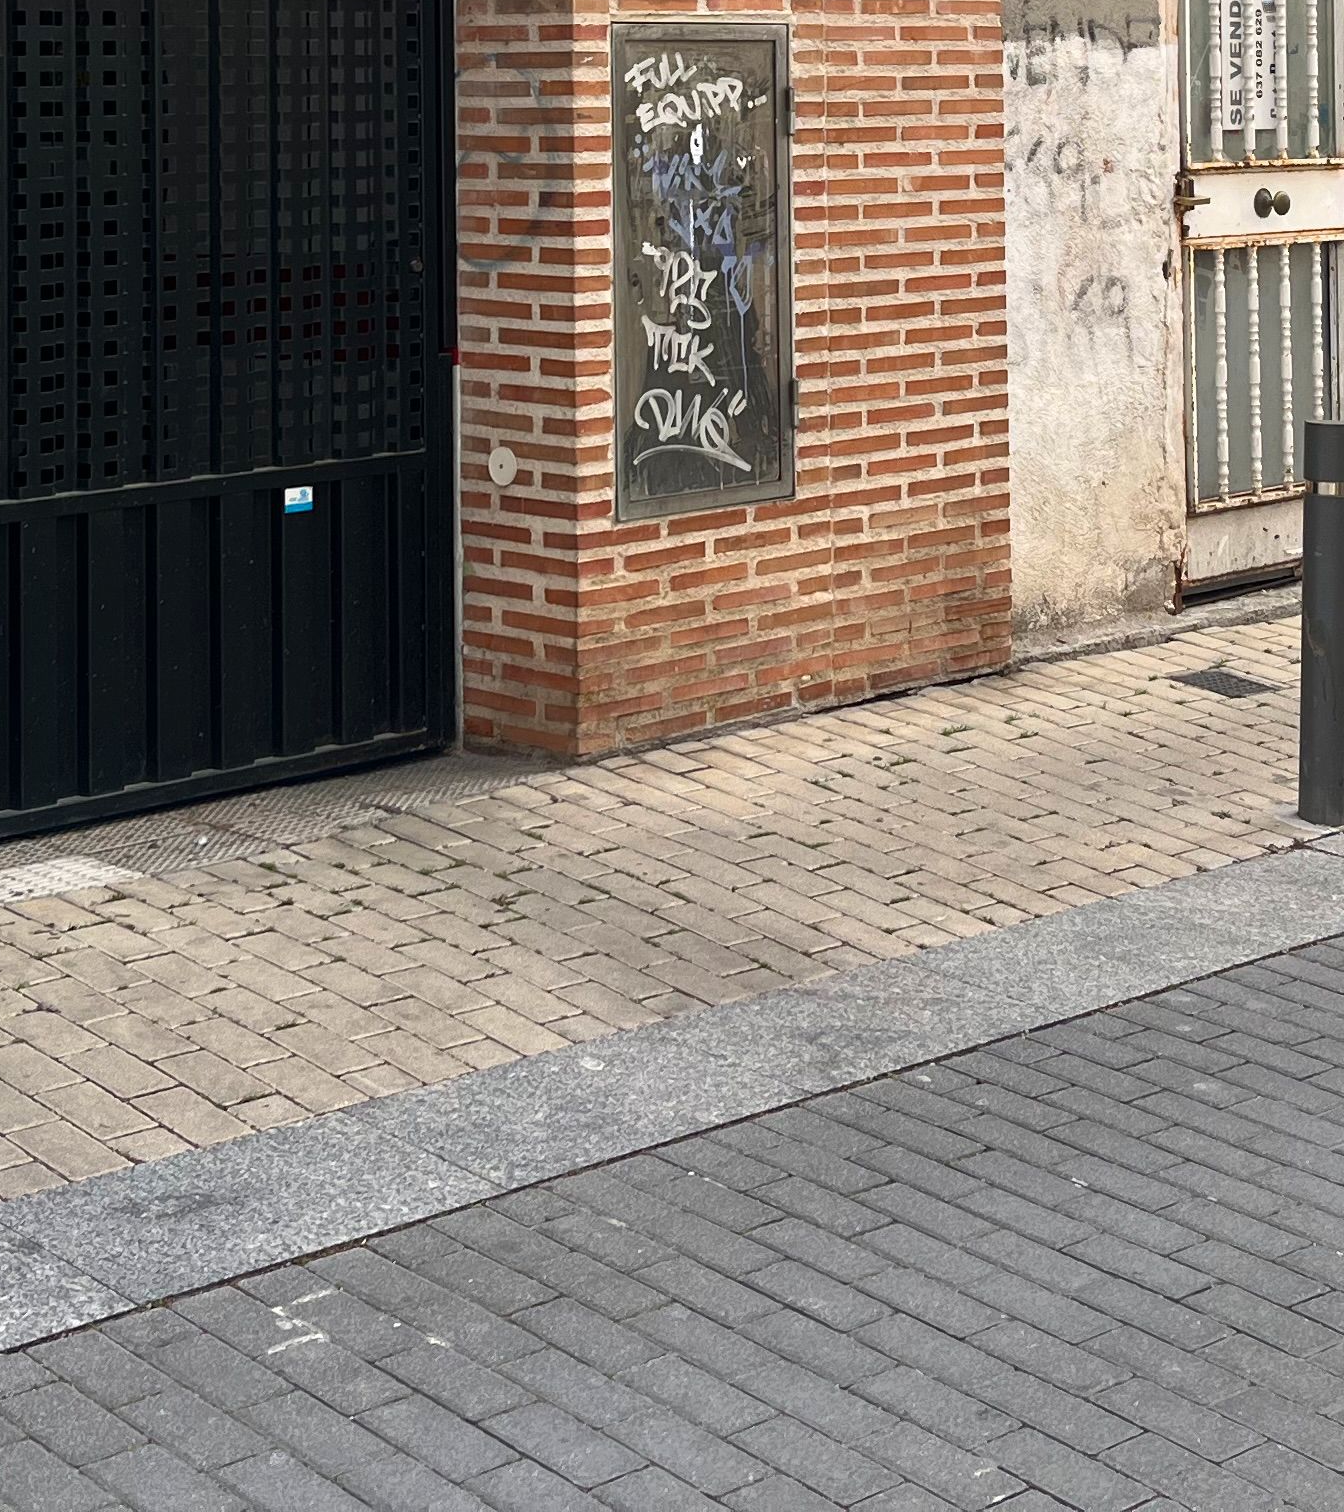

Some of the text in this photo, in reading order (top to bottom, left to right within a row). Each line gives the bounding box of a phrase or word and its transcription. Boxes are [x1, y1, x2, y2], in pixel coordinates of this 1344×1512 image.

[624, 51, 698, 95] FULL
[1255, 72, 1264, 99] 637
[1229, 88, 1244, 126] SE
